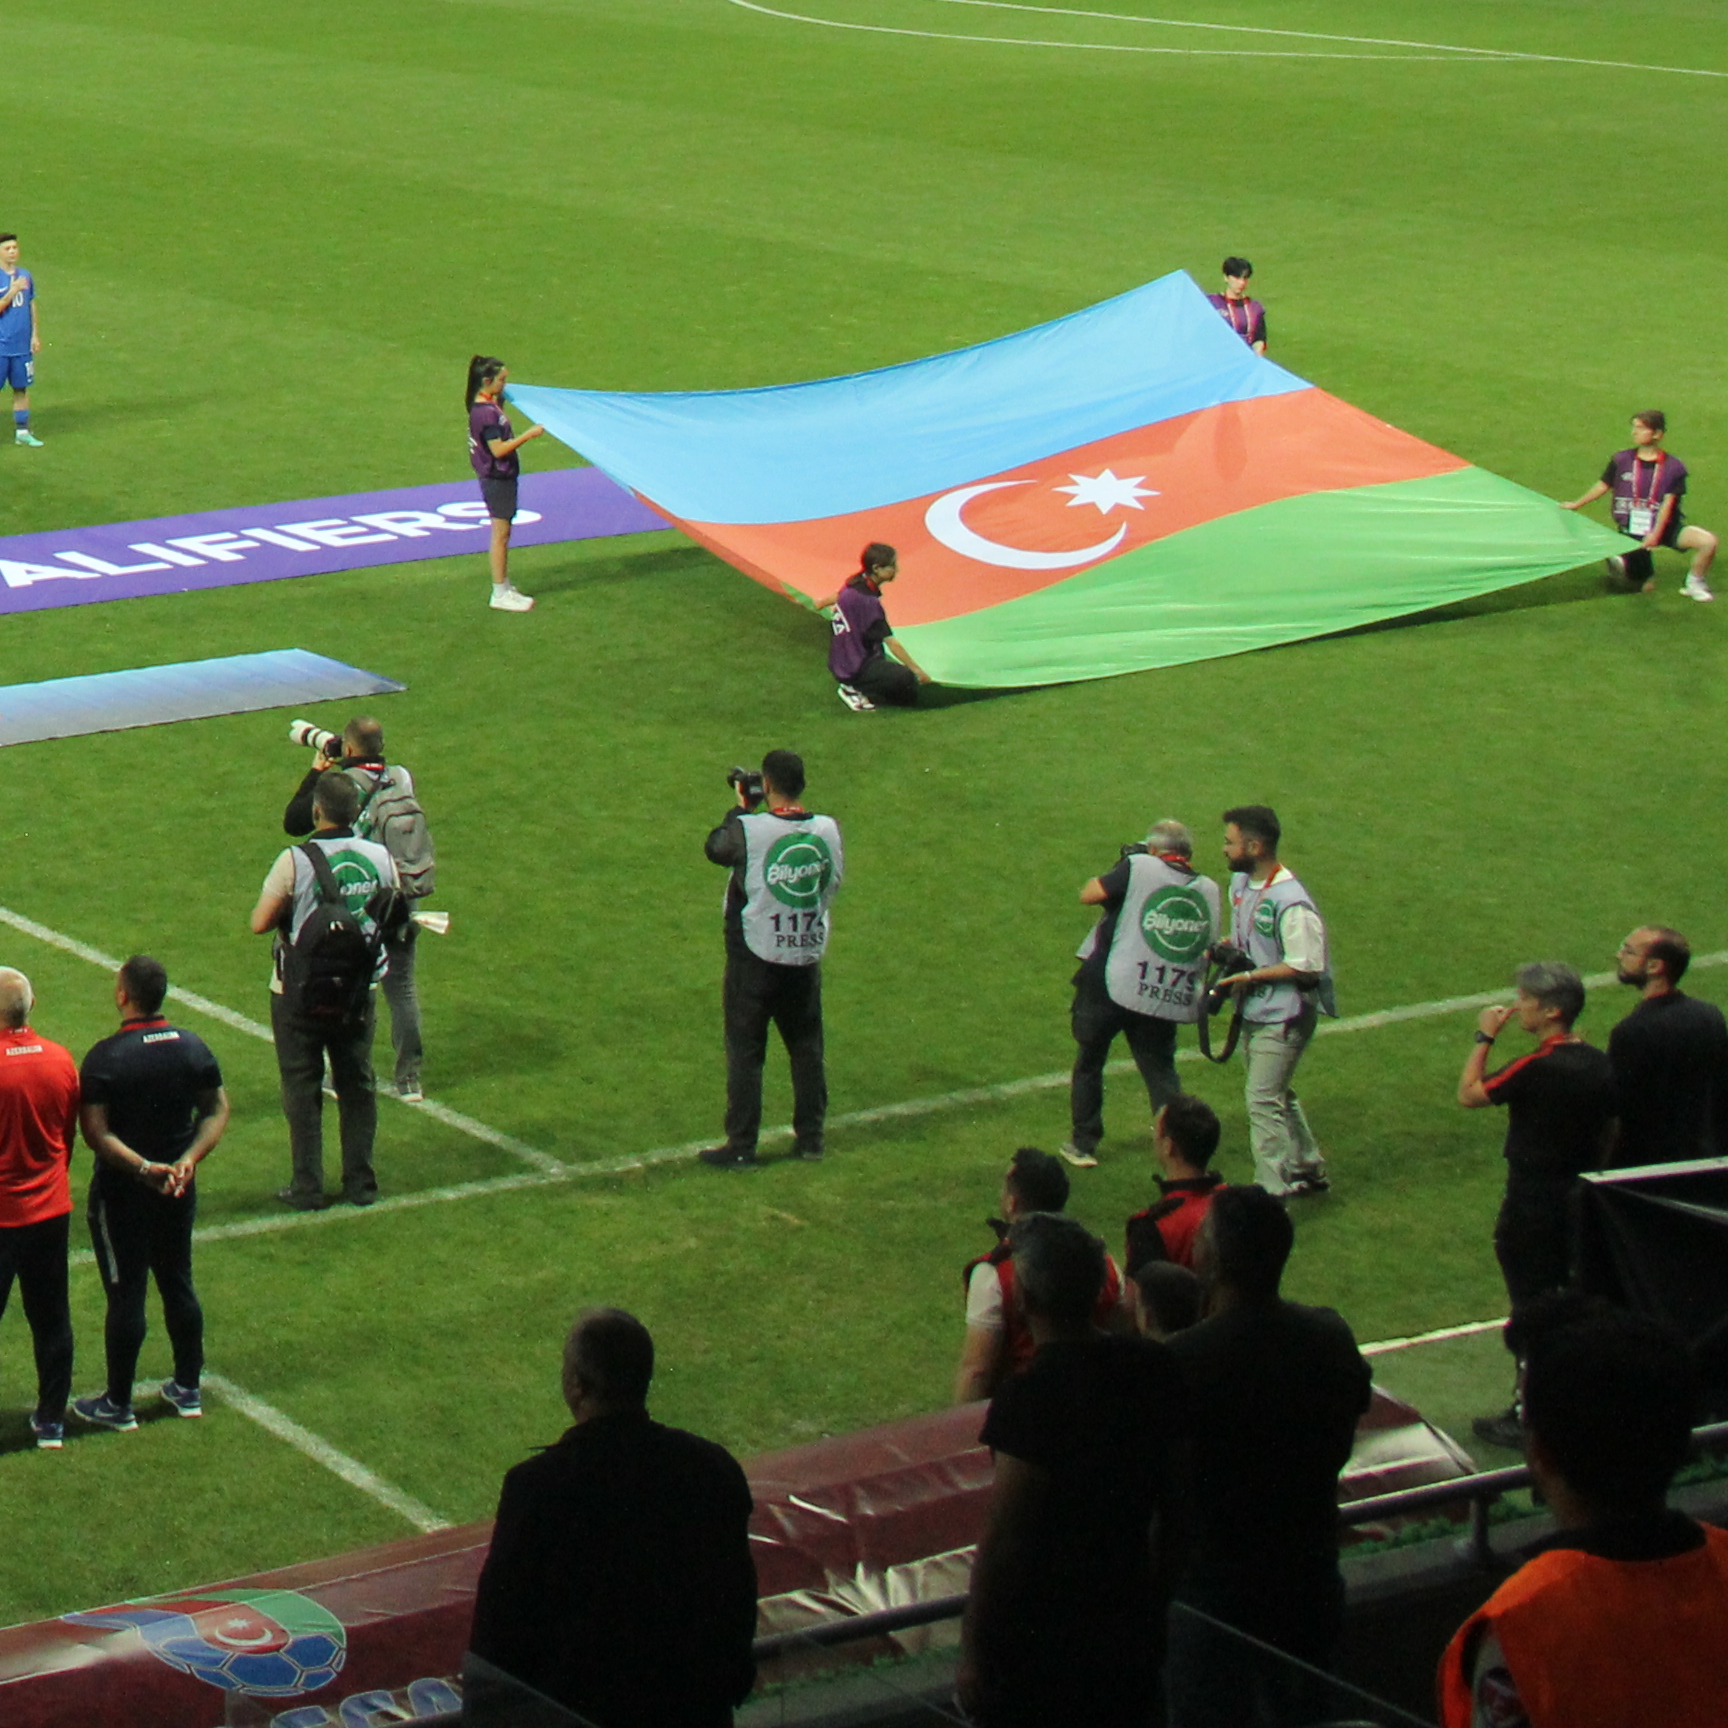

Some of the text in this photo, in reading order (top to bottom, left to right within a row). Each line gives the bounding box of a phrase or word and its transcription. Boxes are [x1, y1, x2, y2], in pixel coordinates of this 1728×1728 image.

[1142, 908, 1209, 936] Bilyoner
[775, 932, 827, 949] PRESS
[1137, 981, 1194, 1007] PRESS
